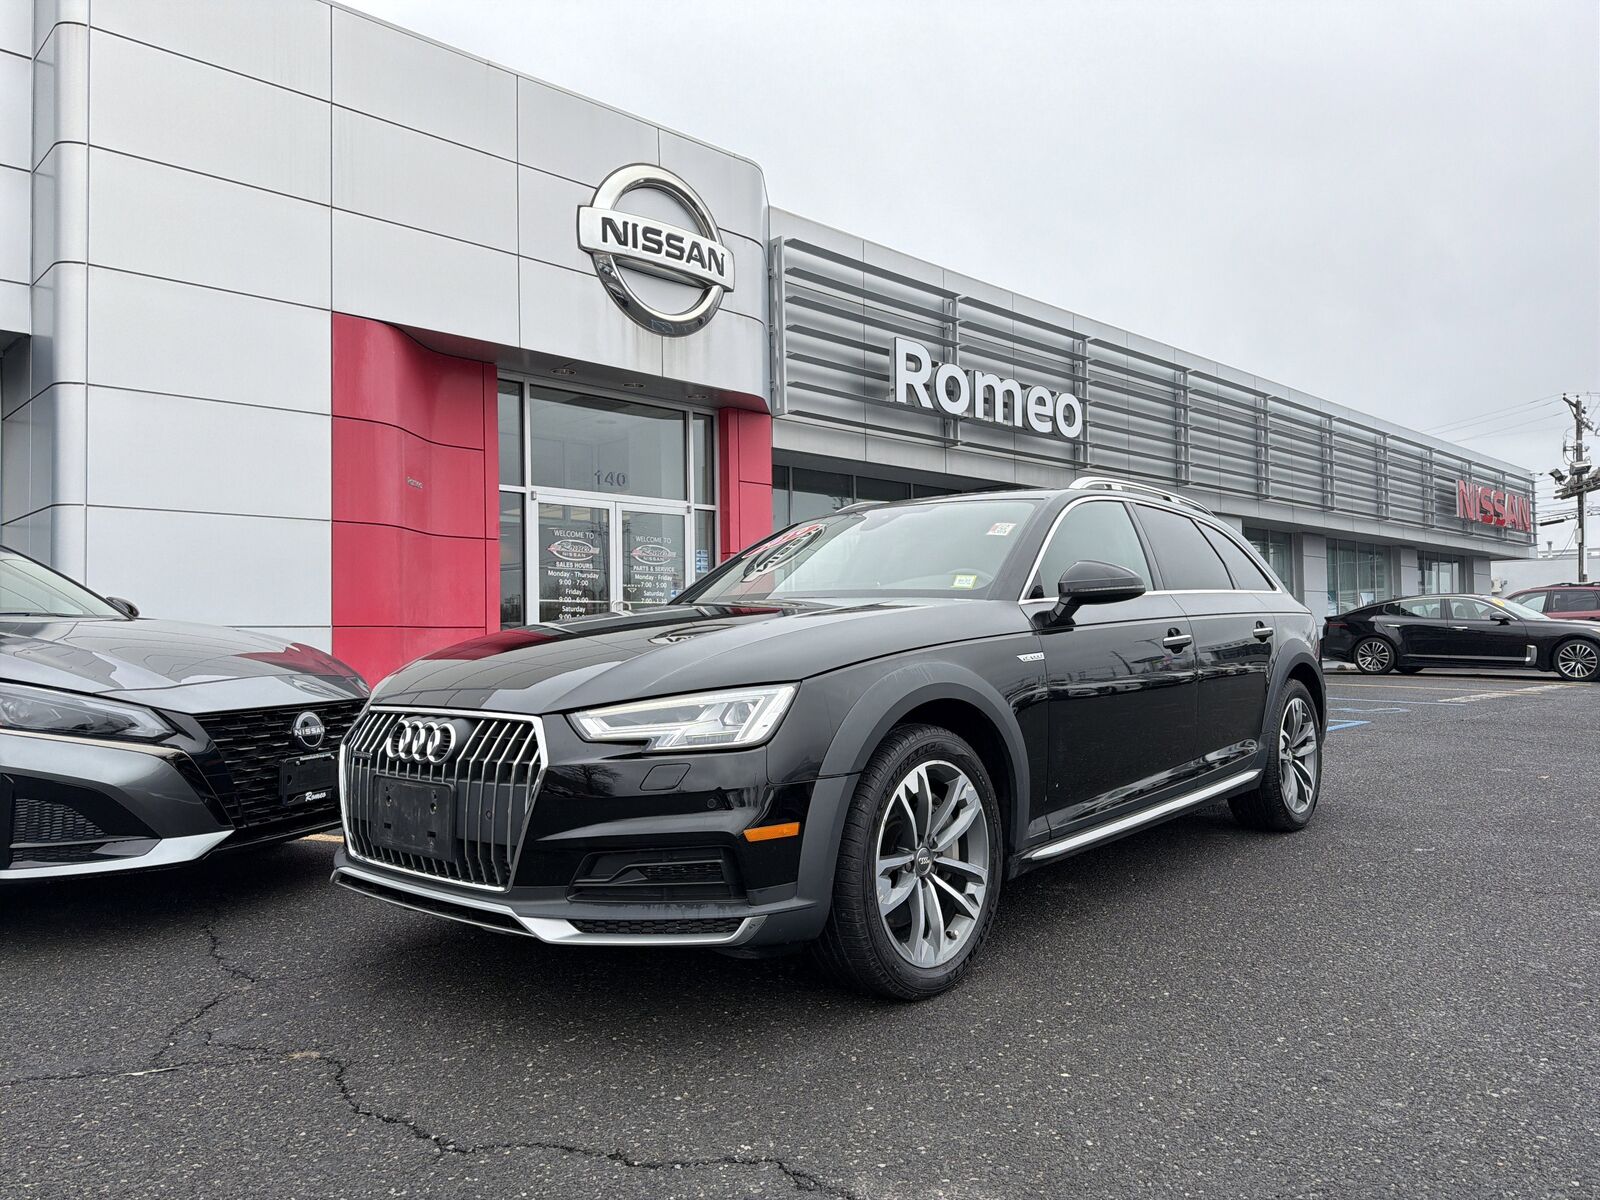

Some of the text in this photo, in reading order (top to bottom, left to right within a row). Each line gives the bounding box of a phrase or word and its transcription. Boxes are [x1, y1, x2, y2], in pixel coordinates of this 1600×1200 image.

[601, 216, 725, 278] NISSAN
[891, 336, 1084, 440] Romeo
[594, 469, 626, 487] 140
[1456, 479, 1532, 533] NISSAN
[553, 529, 595, 540] WELCOME TO
[635, 535, 662, 543] WELCOME
[555, 561, 593, 570] SALES HOURS
[547, 570, 570, 578] Monday
[574, 571, 600, 579] Thursday
[565, 588, 583, 596] Friday
[561, 605, 586, 613] Saturday
[294, 725, 325, 737] NISSAN
[304, 791, 327, 802] Romeo
